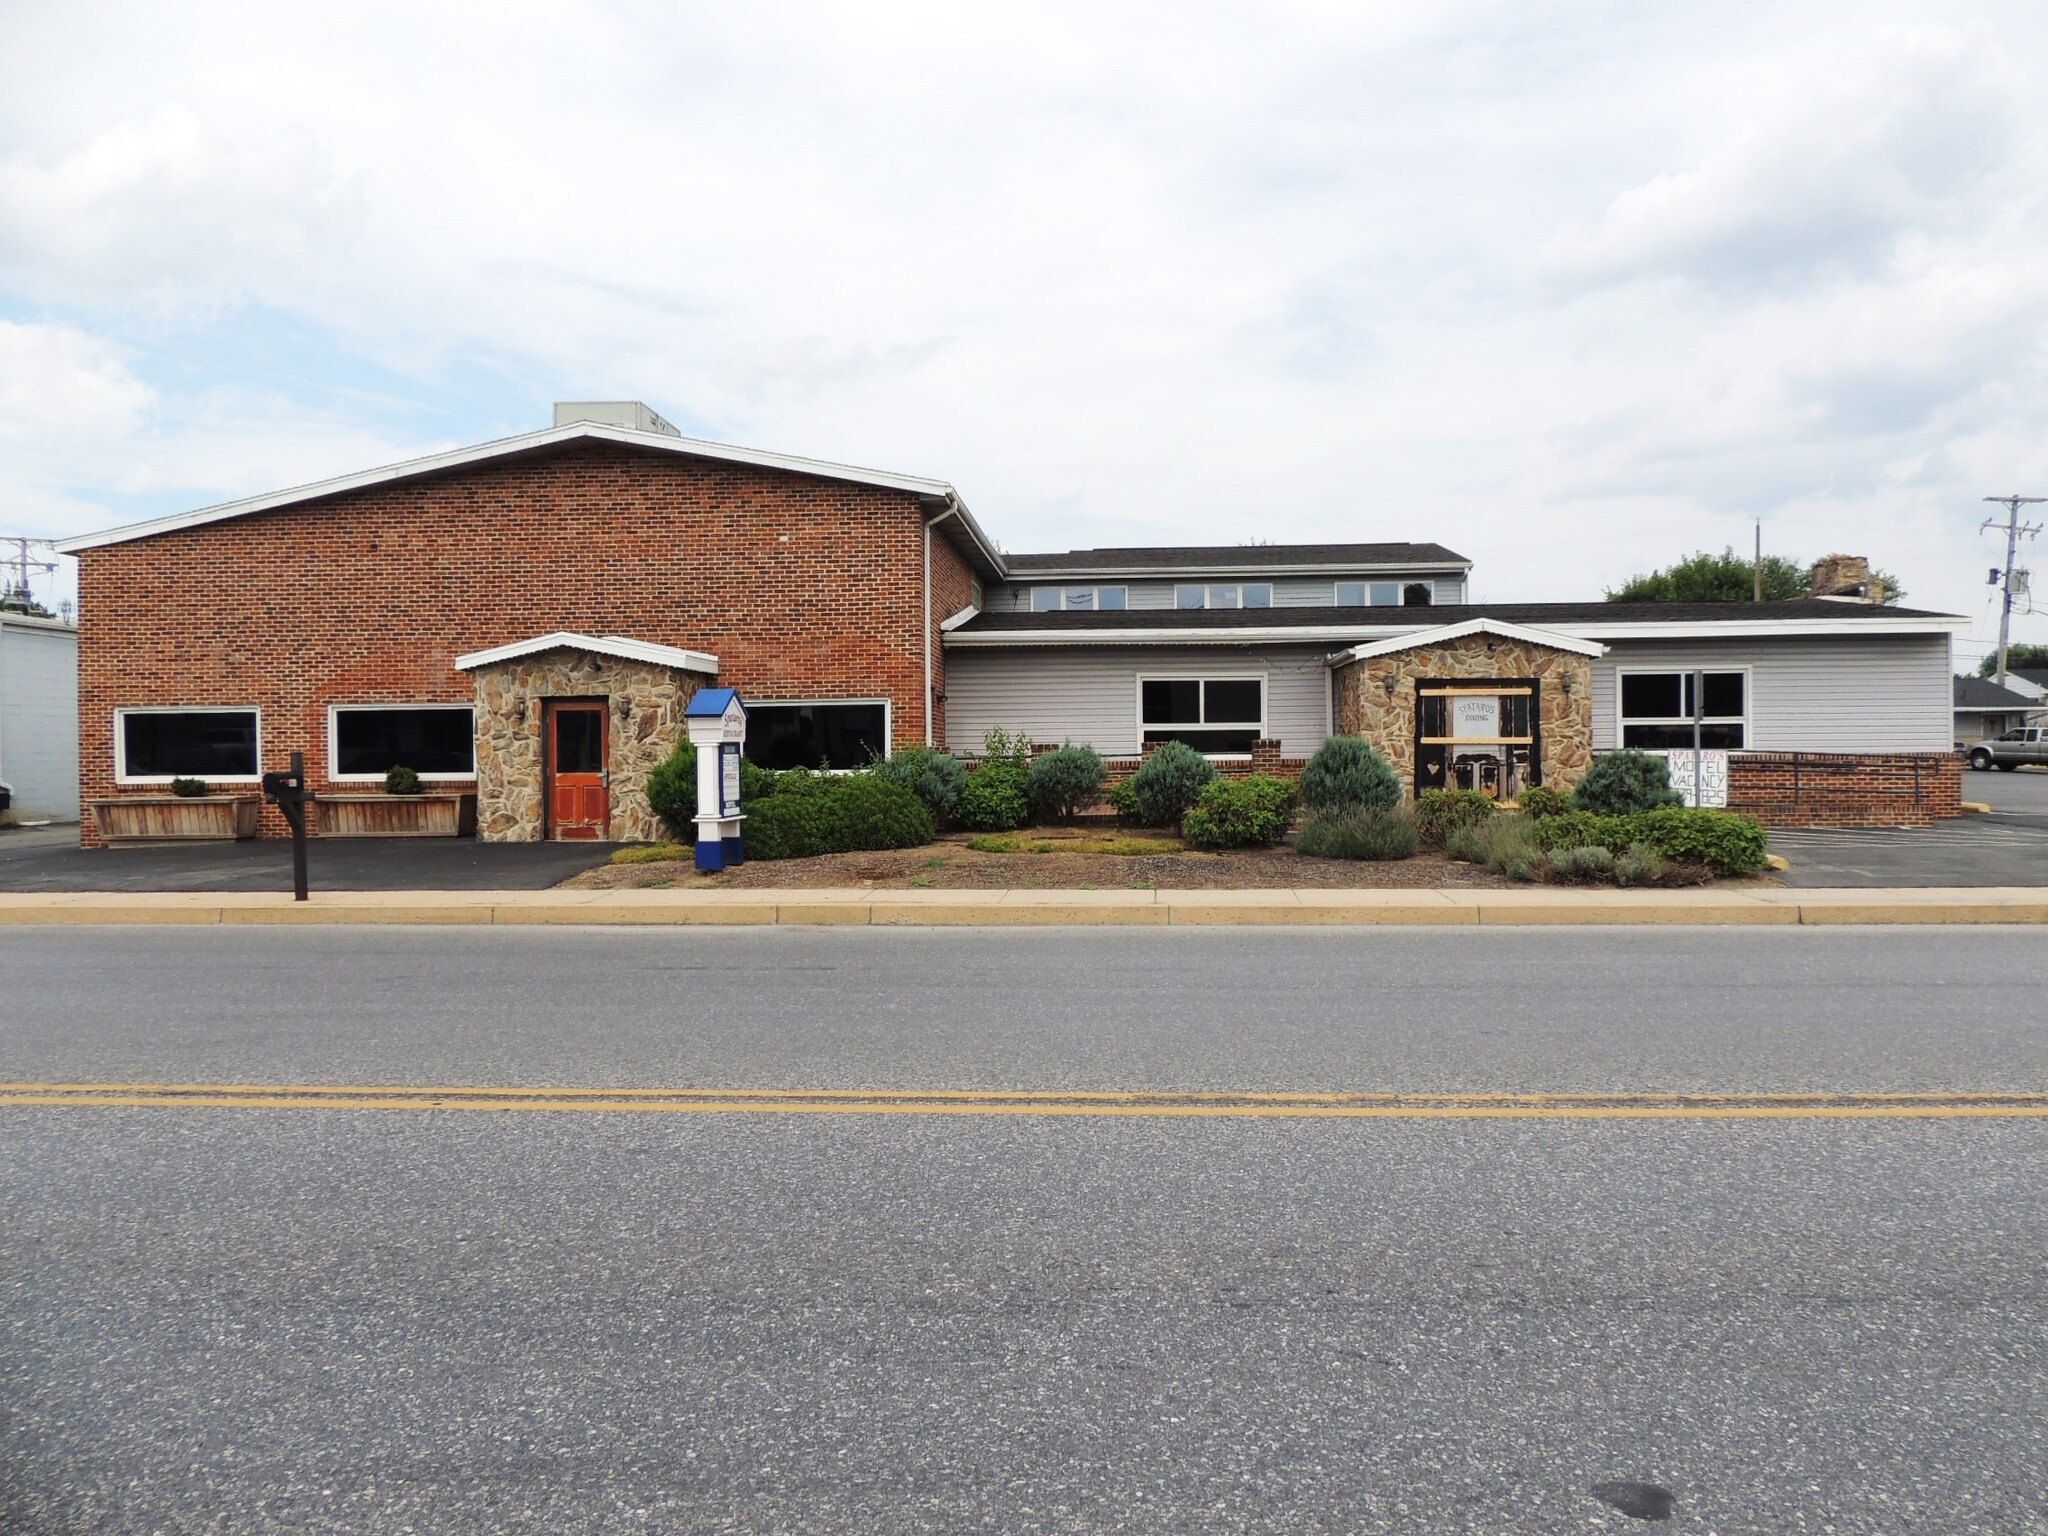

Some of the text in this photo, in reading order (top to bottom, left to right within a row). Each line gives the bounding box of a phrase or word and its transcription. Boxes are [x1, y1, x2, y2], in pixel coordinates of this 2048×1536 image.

[1672, 751, 1725, 760] SPATRO'S
[1671, 774, 1725, 788] VACNCY
[1676, 788, 1725, 805] 79-825
